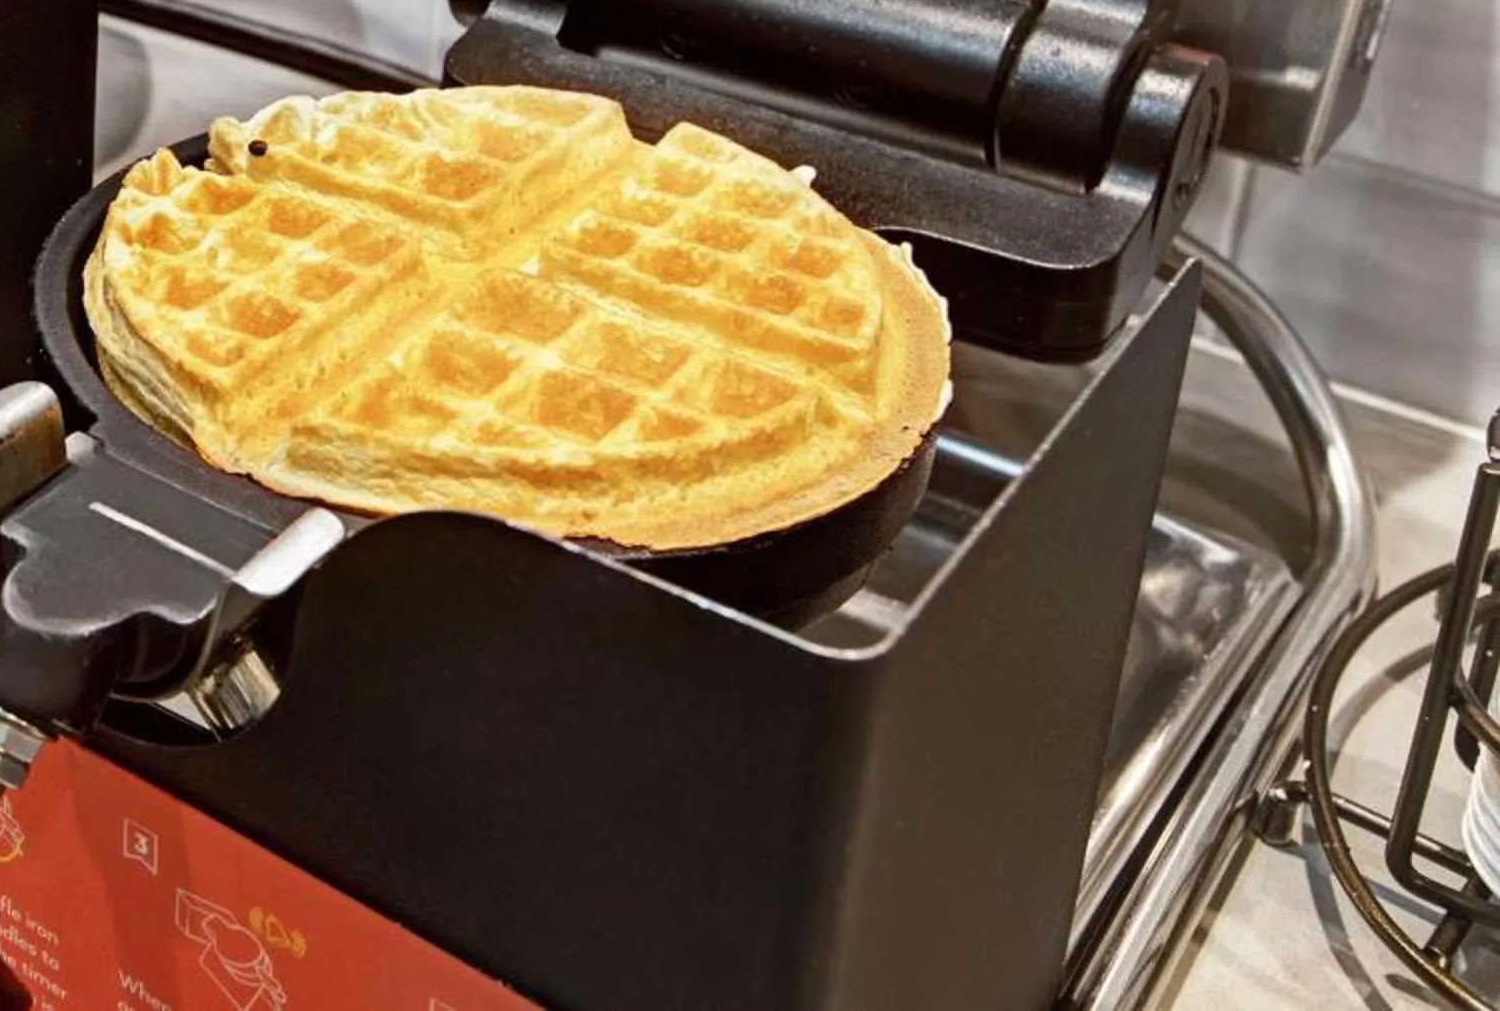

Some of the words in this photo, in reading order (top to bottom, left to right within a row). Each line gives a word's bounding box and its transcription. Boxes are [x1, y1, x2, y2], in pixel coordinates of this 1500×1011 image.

[134, 832, 149, 855] 3
[26, 911, 58, 946] iron
[41, 950, 60, 971] to
[22, 962, 67, 1000] timer
